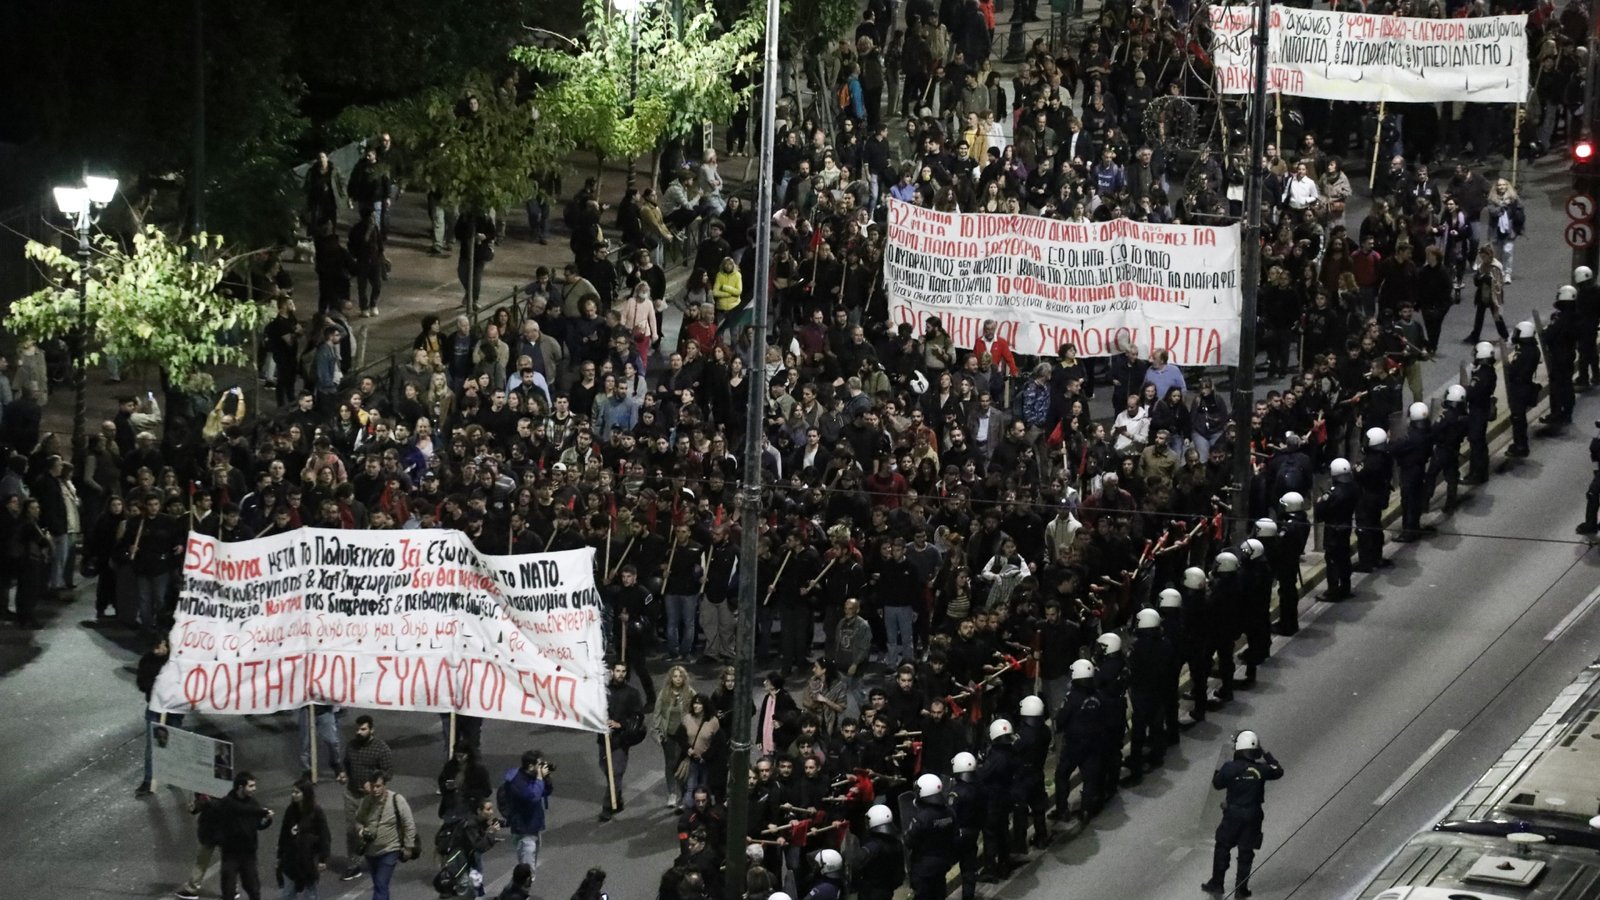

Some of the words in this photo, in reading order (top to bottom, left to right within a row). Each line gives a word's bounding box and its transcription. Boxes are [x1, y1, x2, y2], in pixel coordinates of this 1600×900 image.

[911, 219, 946, 237] ΜΕΤΑ
[912, 206, 952, 226] ΧΡΟΝΙΑ
[959, 214, 974, 238] ΤΟ
[1048, 221, 1089, 243] ΔΕΙΧΝΕΙ
[1100, 219, 1140, 242] ΔΡΟΜΟ
[1142, 231, 1188, 246] ΑΓΩΝΕΣ
[1193, 227, 1216, 247] ΓΙΑ
[1068, 248, 1080, 268] ΟΙ
[1131, 244, 1142, 265] ΤΟ
[1145, 249, 1171, 270] ΝΑΤΟ
[996, 275, 1011, 295] ΤΟ
[1069, 284, 1116, 303] ΚΙΝΗΜΑ
[1119, 282, 1133, 299] ΘΑ
[1168, 270, 1181, 289] ΓΙΑ
[1183, 269, 1237, 290] ΔΙΑΓΡΑΦΕΣ
[1093, 303, 1107, 314] τον
[184, 538, 214, 576] 52
[300, 541, 312, 566] το
[315, 535, 395, 568] Πολυτεχνείο
[305, 569, 315, 589] &
[412, 567, 434, 589] δεν
[436, 566, 455, 588] θα
[327, 592, 393, 617] διαγραφές
[183, 653, 356, 711] ΦΟΙΤΗΤΙΚΟΙ
[375, 655, 506, 712] ΣΥΛΛΟΓΟΙ
[518, 670, 581, 722] ΕΜΠ
